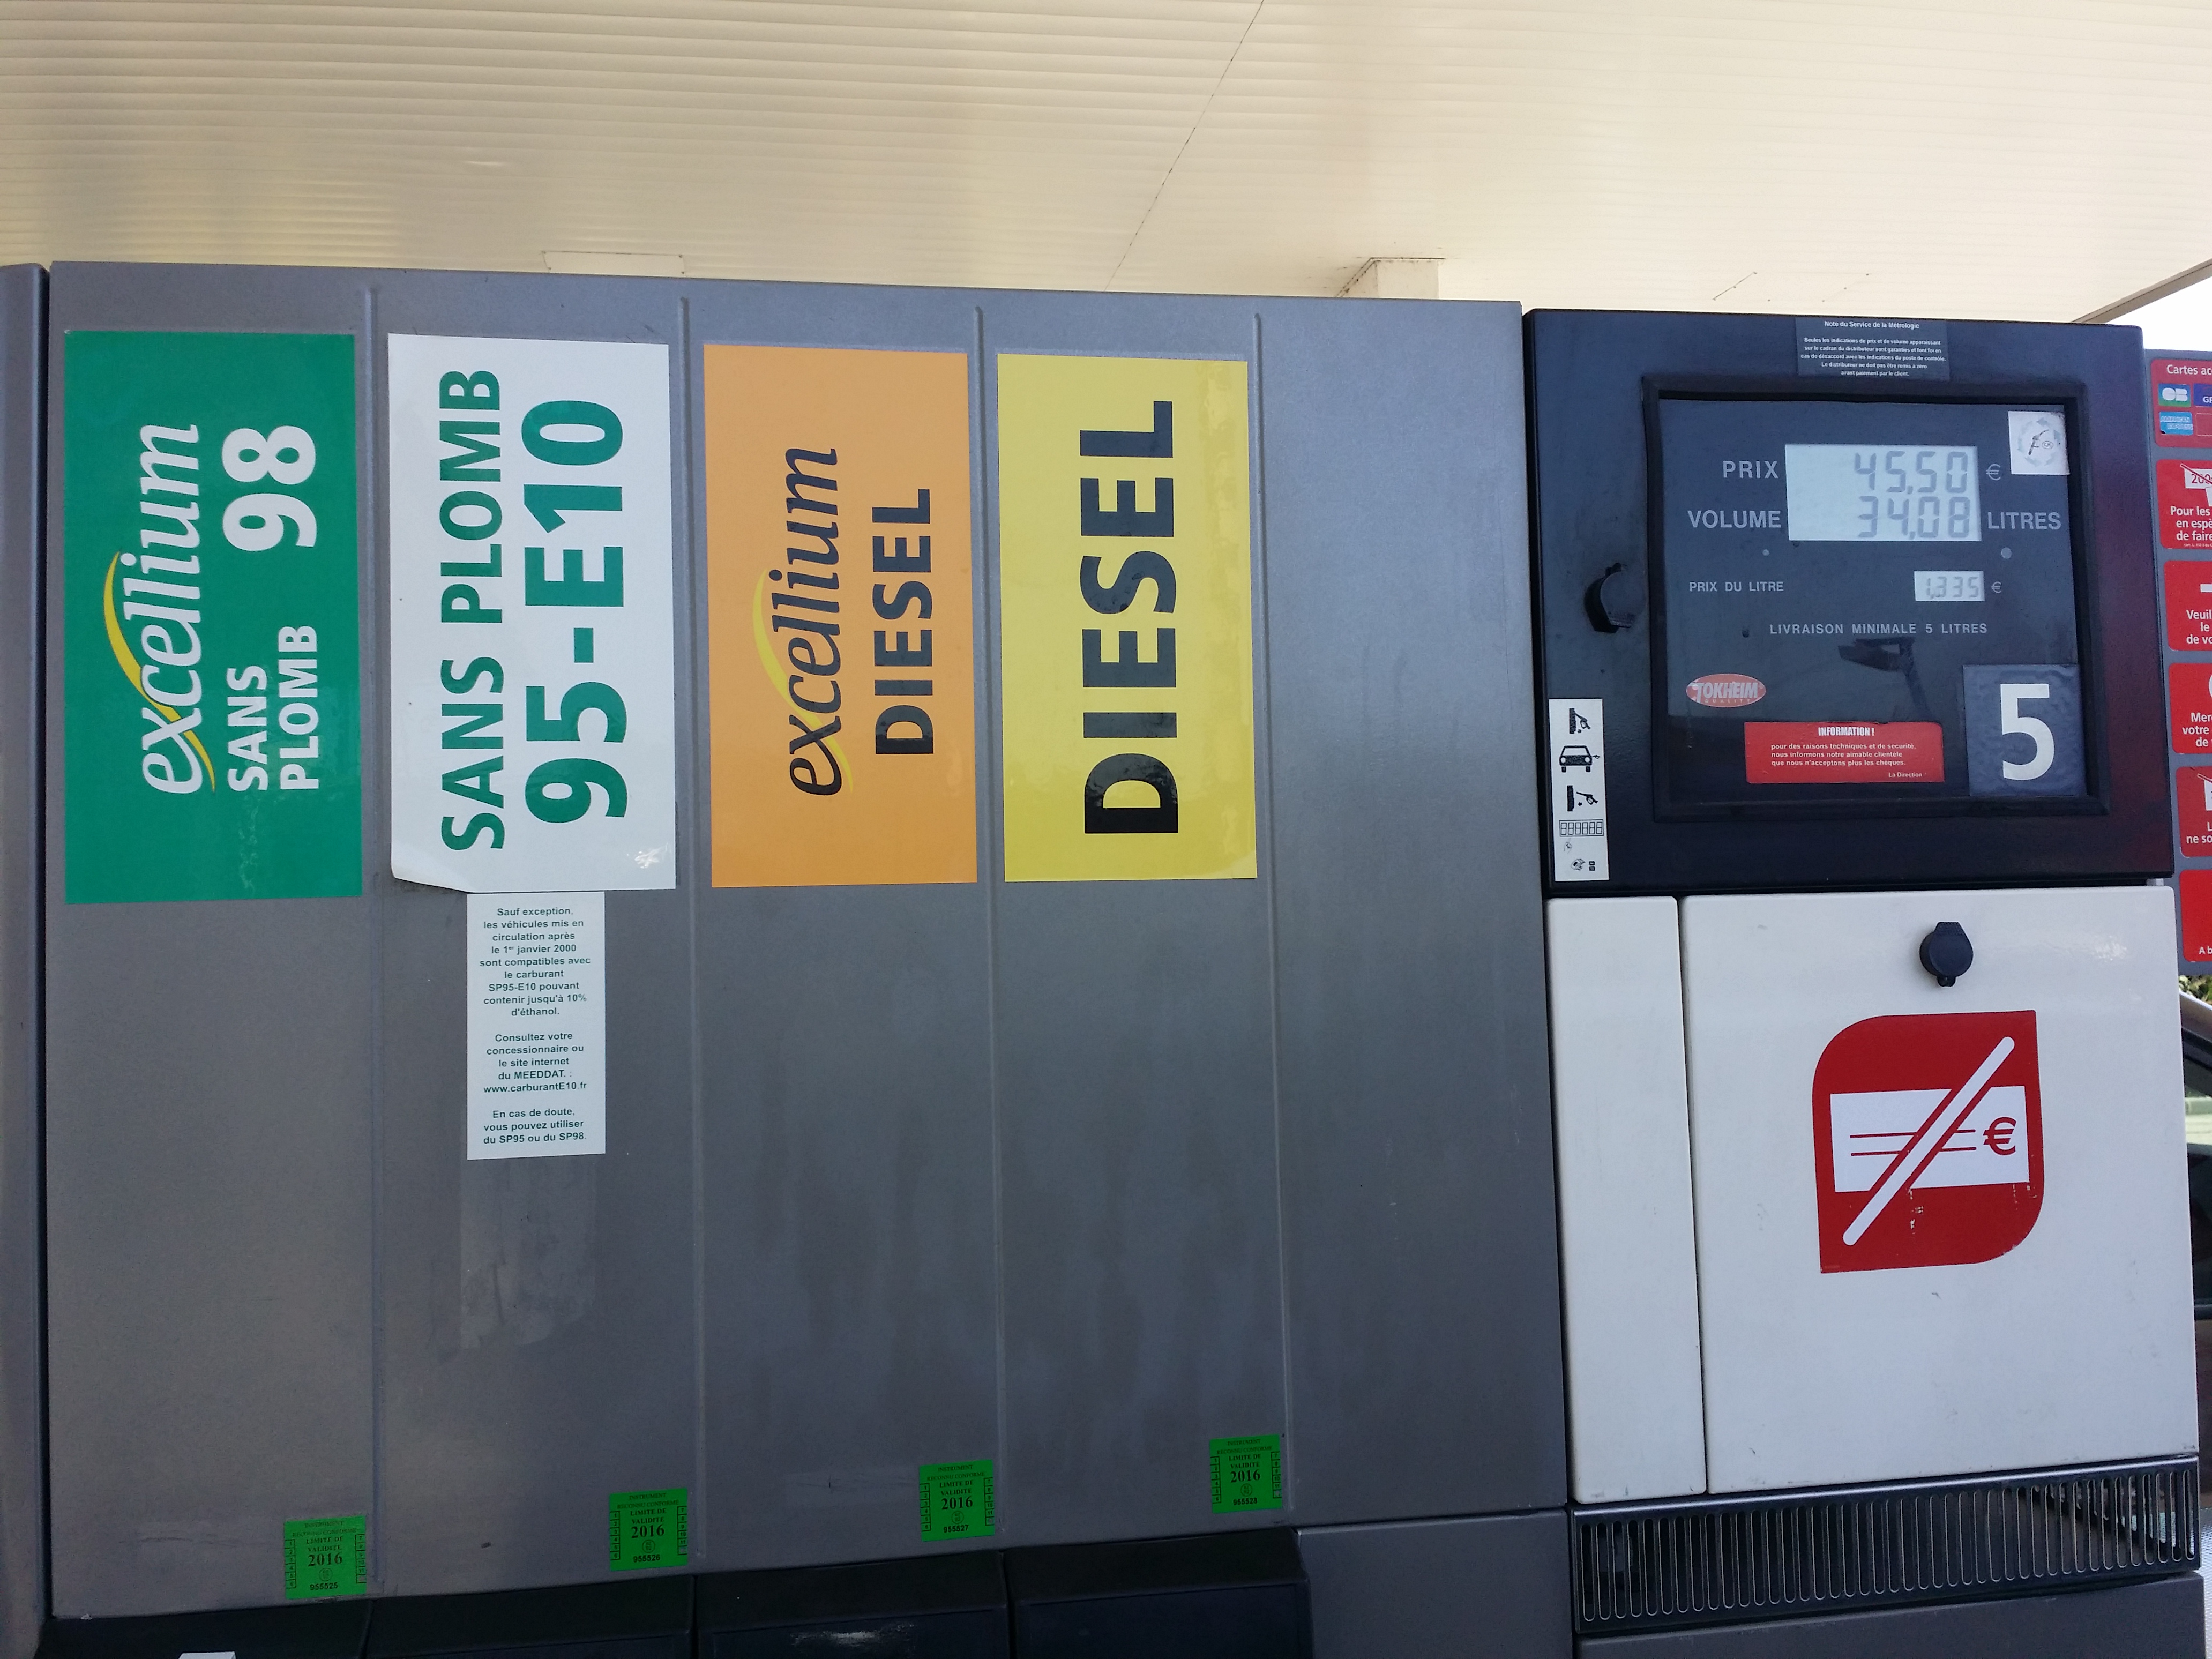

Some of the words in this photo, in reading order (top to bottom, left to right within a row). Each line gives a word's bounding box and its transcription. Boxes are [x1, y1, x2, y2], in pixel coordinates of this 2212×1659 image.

[2166, 364, 2198, 375] Cartes
[1723, 460, 1778, 478] PRIX
[1855, 450, 1968, 494] 45,50
[1985, 464, 2001, 480] €
[222, 426, 316, 551] 98
[439, 371, 503, 623] PLOMB
[2170, 505, 2194, 516] Pour
[2196, 505, 2210, 516] les
[1687, 510, 1781, 528] VOLUME
[1857, 495, 1970, 539] 34,08
[1987, 512, 2061, 529] LITRES
[2176, 520, 2189, 528] en
[2176, 530, 2189, 541] de
[1690, 581, 1717, 592] PRIX
[1725, 581, 1742, 591] DU
[1749, 581, 1783, 591] LITRE
[1991, 581, 2001, 593] €
[121, 425, 202, 793] excellium
[521, 401, 628, 823] 95-E10
[769, 449, 842, 795] excellium
[872, 489, 933, 754] DIESEL
[1080, 401, 1178, 834] DIESEL
[1770, 624, 1843, 634] LIVRAISON
[1852, 623, 1916, 633] MINIMALE
[1925, 624, 1932, 633] 5
[1941, 623, 1987, 633] LITRES
[2200, 622, 2210, 632] le
[2186, 634, 2199, 644] de
[1688, 682, 1758, 703] TOKHEIM
[279, 626, 318, 789] PLOMB
[227, 666, 268, 791] SANS
[1818, 727, 1870, 735] INFORMATION
[2000, 683, 2054, 780] 5
[2182, 726, 2209, 735] votre
[2195, 737, 2209, 747] de
[440, 657, 505, 850] SANS
[2186, 836, 2199, 844] ne
[497, 908, 519, 916] Sauf
[522, 907, 572, 916] exception,
[501, 920, 548, 928] véhicules
[492, 932, 544, 941] circulation
[548, 931, 574, 941] après
[517, 945, 551, 955] janvier
[554, 944, 576, 952] 2000
[2199, 946, 2206, 954] A
[505, 957, 564, 967] compatibles
[516, 970, 563, 978] carburant
[489, 983, 536, 991] SP95-E10
[540, 982, 579, 991] pouvant
[483, 996, 525, 1004] contenir
[527, 995, 563, 1005] jusqu'à
[567, 993, 586, 1002] 10%
[511, 1007, 559, 1016] d'éthanol.
[495, 1033, 544, 1042] Consultez
[487, 1045, 568, 1055] concessionnaire
[514, 1070, 565, 1079] MEEDDAT.
[483, 1081, 586, 1093] www.carburantE10.fr
[511, 1123, 547, 1132] pouvez
[550, 1120, 584, 1128] utiliser
[499, 1134, 524, 1143] SP95
[1983, 1117, 2016, 1155] €
[1230, 1469, 1260, 1482] 2016
[941, 1496, 973, 1509] 2016
[1233, 1497, 1257, 1505] 955528
[631, 1524, 664, 1538] 2016
[943, 1525, 968, 1533] 955527
[308, 1553, 342, 1566] 2016
[633, 1554, 660, 1562] 955526
